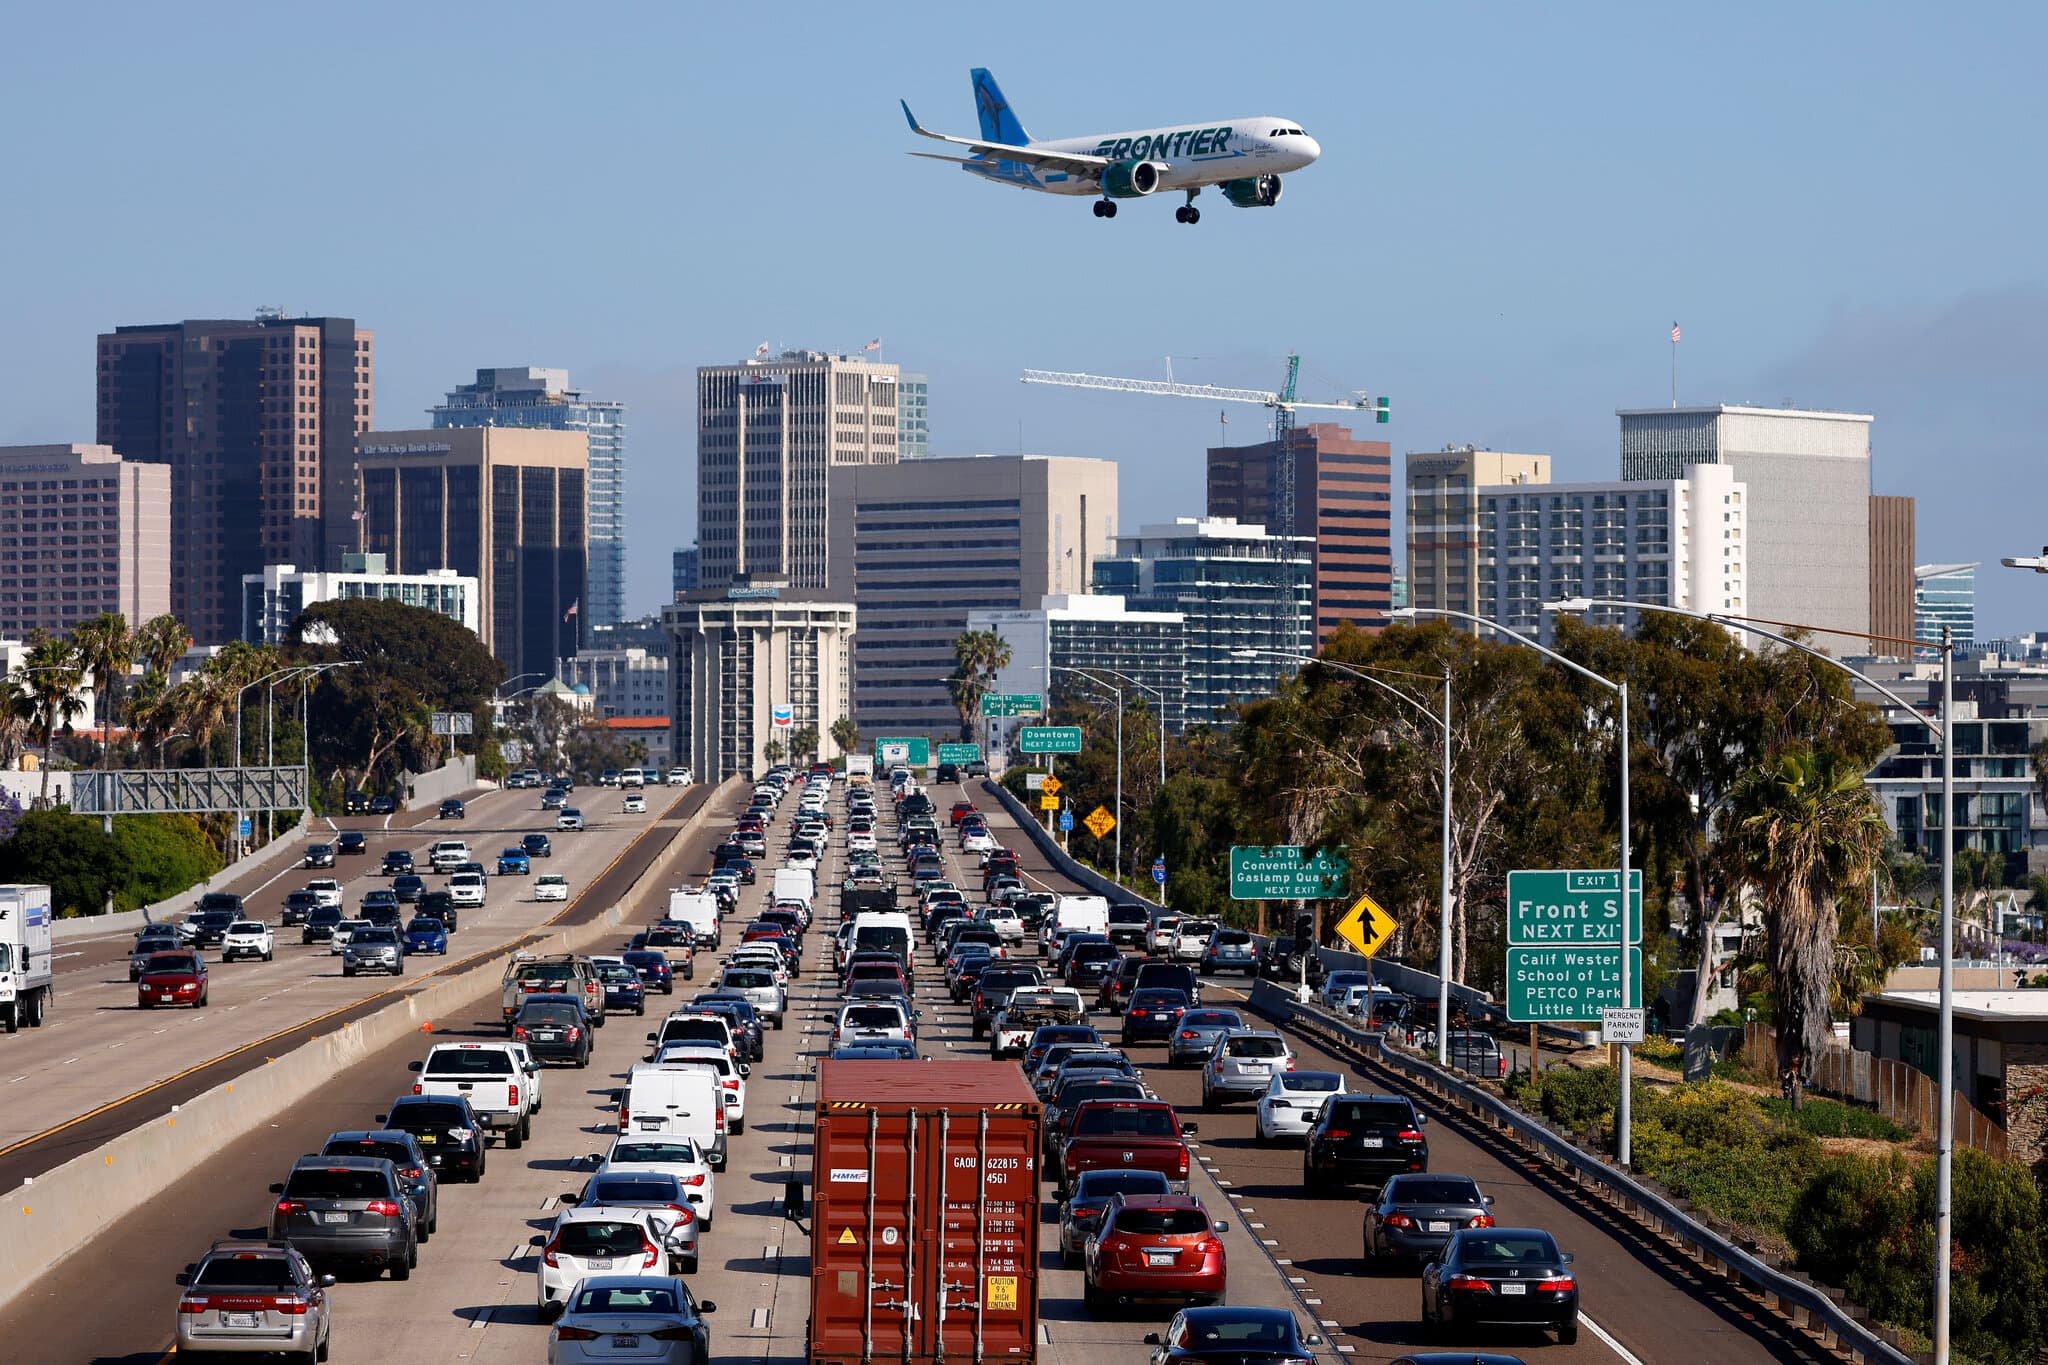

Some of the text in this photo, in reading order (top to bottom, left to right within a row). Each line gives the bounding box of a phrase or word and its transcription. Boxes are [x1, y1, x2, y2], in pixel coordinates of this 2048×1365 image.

[1097, 127, 1232, 161] FRONTIER
[1288, 849, 1322, 858] Dio
[1242, 861, 1313, 870] Convention
[1158, 872, 1165, 880] 5
[1237, 872, 1290, 883] Gaslamp
[1577, 876, 1606, 886] EXIT
[1265, 886, 1317, 894] NEXT EXIT
[1519, 900, 1589, 919] Front
[1522, 924, 1574, 938] NEXT
[1520, 954, 1619, 965] Calif Wester
[1517, 970, 1631, 981] School of La
[1526, 987, 1621, 999] PETCO Park
[1529, 1003, 1574, 1015] Little
[1604, 1011, 1642, 1019] EMERGENCY
[1607, 1021, 1640, 1029] PARKING
[953, 1157, 1033, 1170] GAOU 622815 4
[986, 1173, 1007, 1184] 45G1
[1005, 1206, 1015, 1214] LBS
[990, 1277, 1015, 1286] CAUTION
[987, 1301, 1016, 1309] CONTAINER
